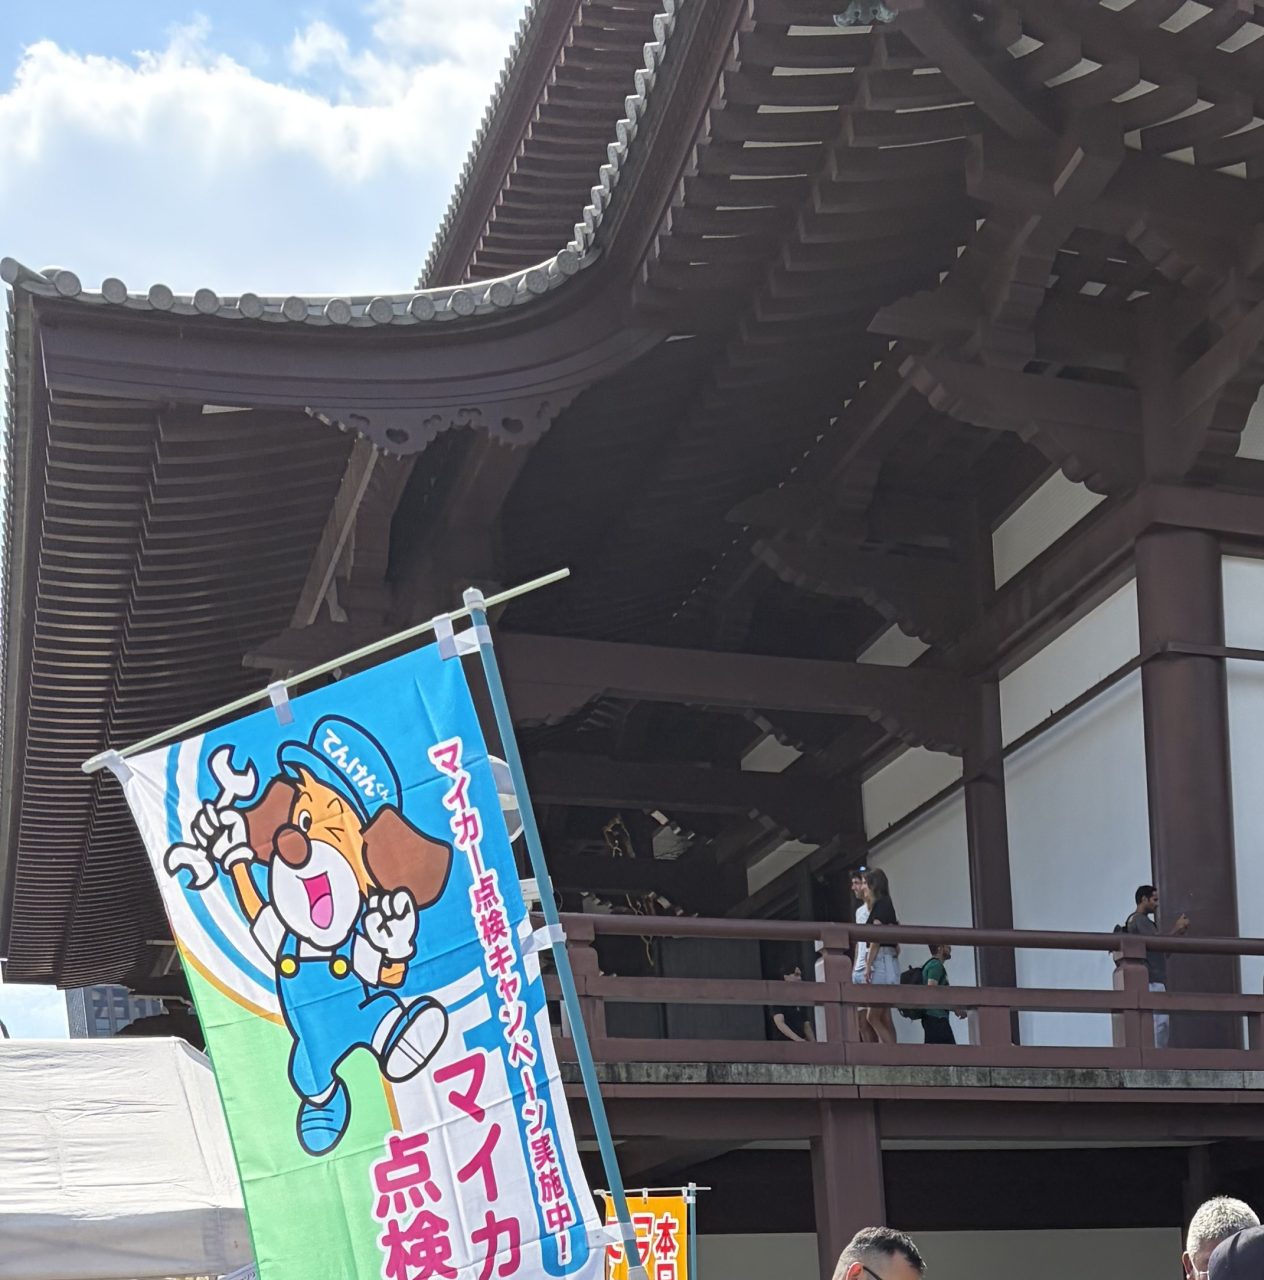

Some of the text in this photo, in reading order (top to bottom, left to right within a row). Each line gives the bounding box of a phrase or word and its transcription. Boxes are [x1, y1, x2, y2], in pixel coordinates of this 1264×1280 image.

[323, 728, 389, 800] てんけんくん
